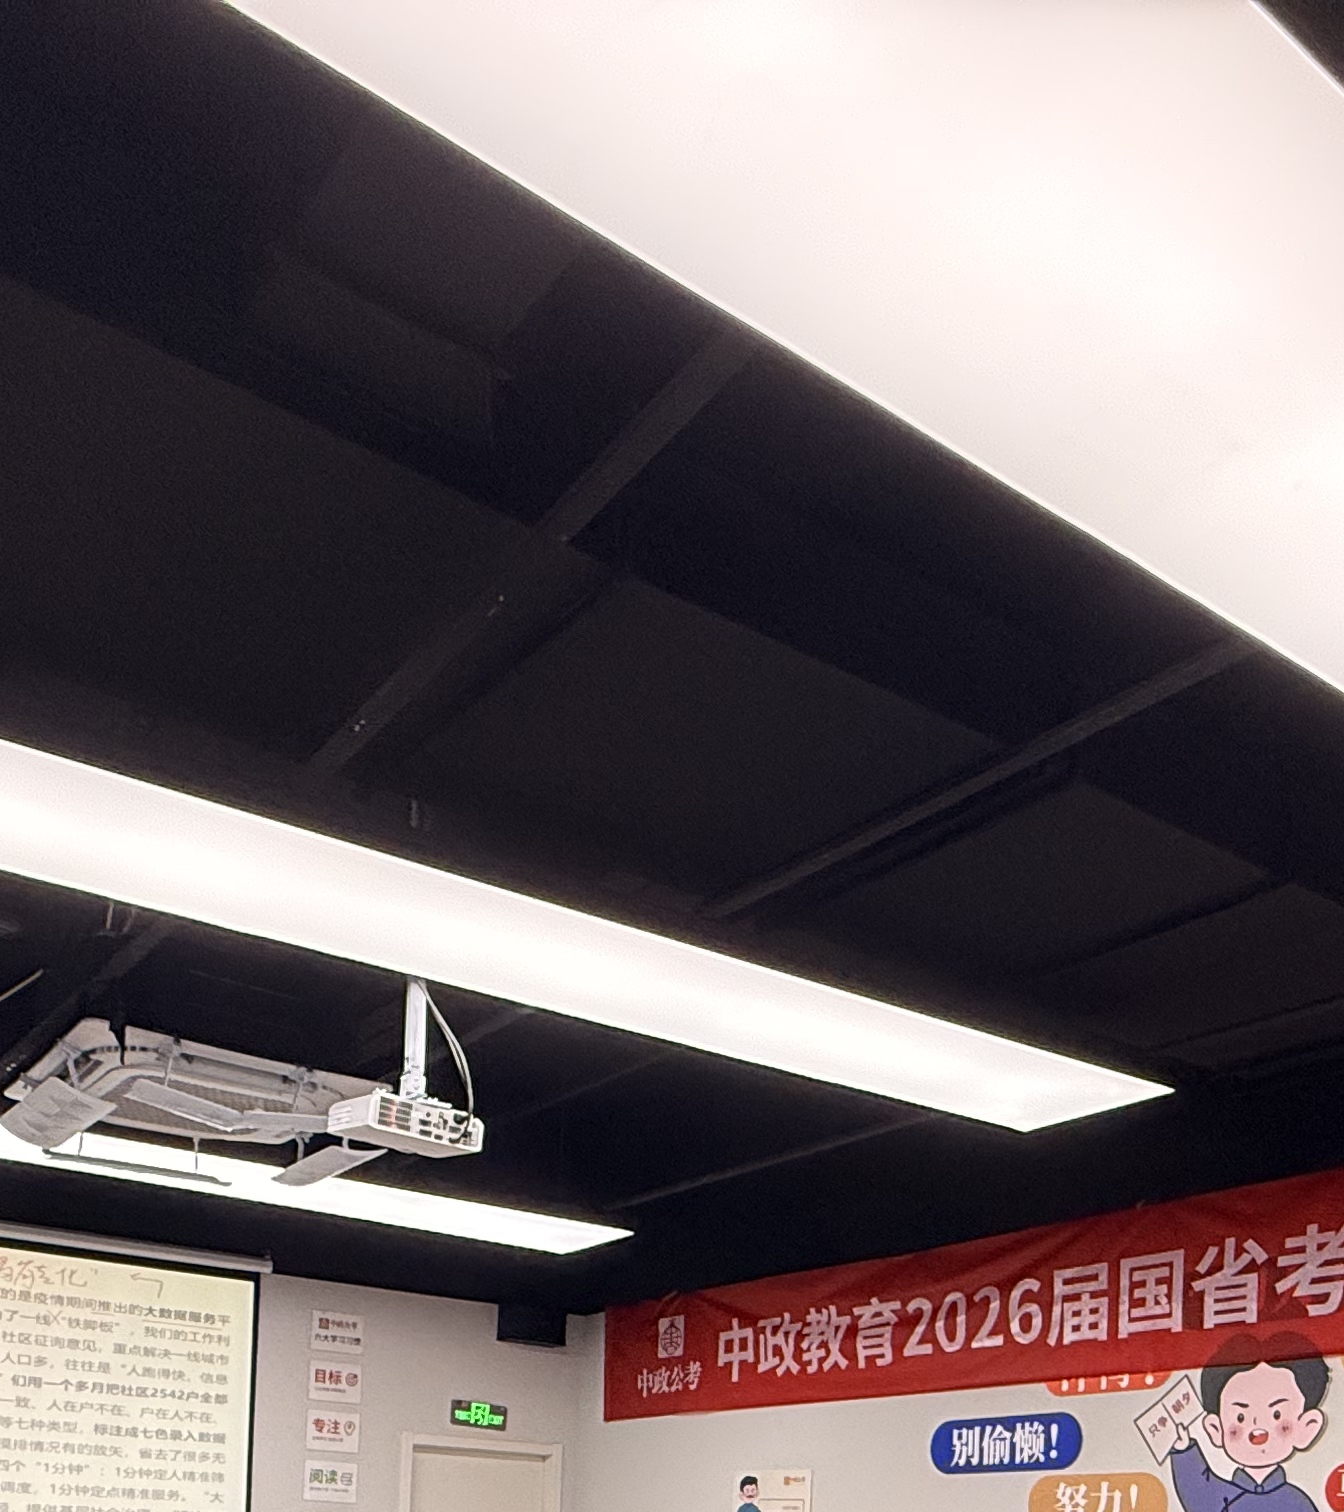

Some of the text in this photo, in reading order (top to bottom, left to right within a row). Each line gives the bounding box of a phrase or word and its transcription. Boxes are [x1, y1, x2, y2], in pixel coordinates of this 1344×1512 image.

[315, 1368, 342, 1385] 目标
[637, 1359, 702, 1398] 中政公考
[312, 1418, 340, 1435] 专注
[950, 1420, 1060, 1468] 别偷懒！
[309, 1468, 338, 1486] 阅读
